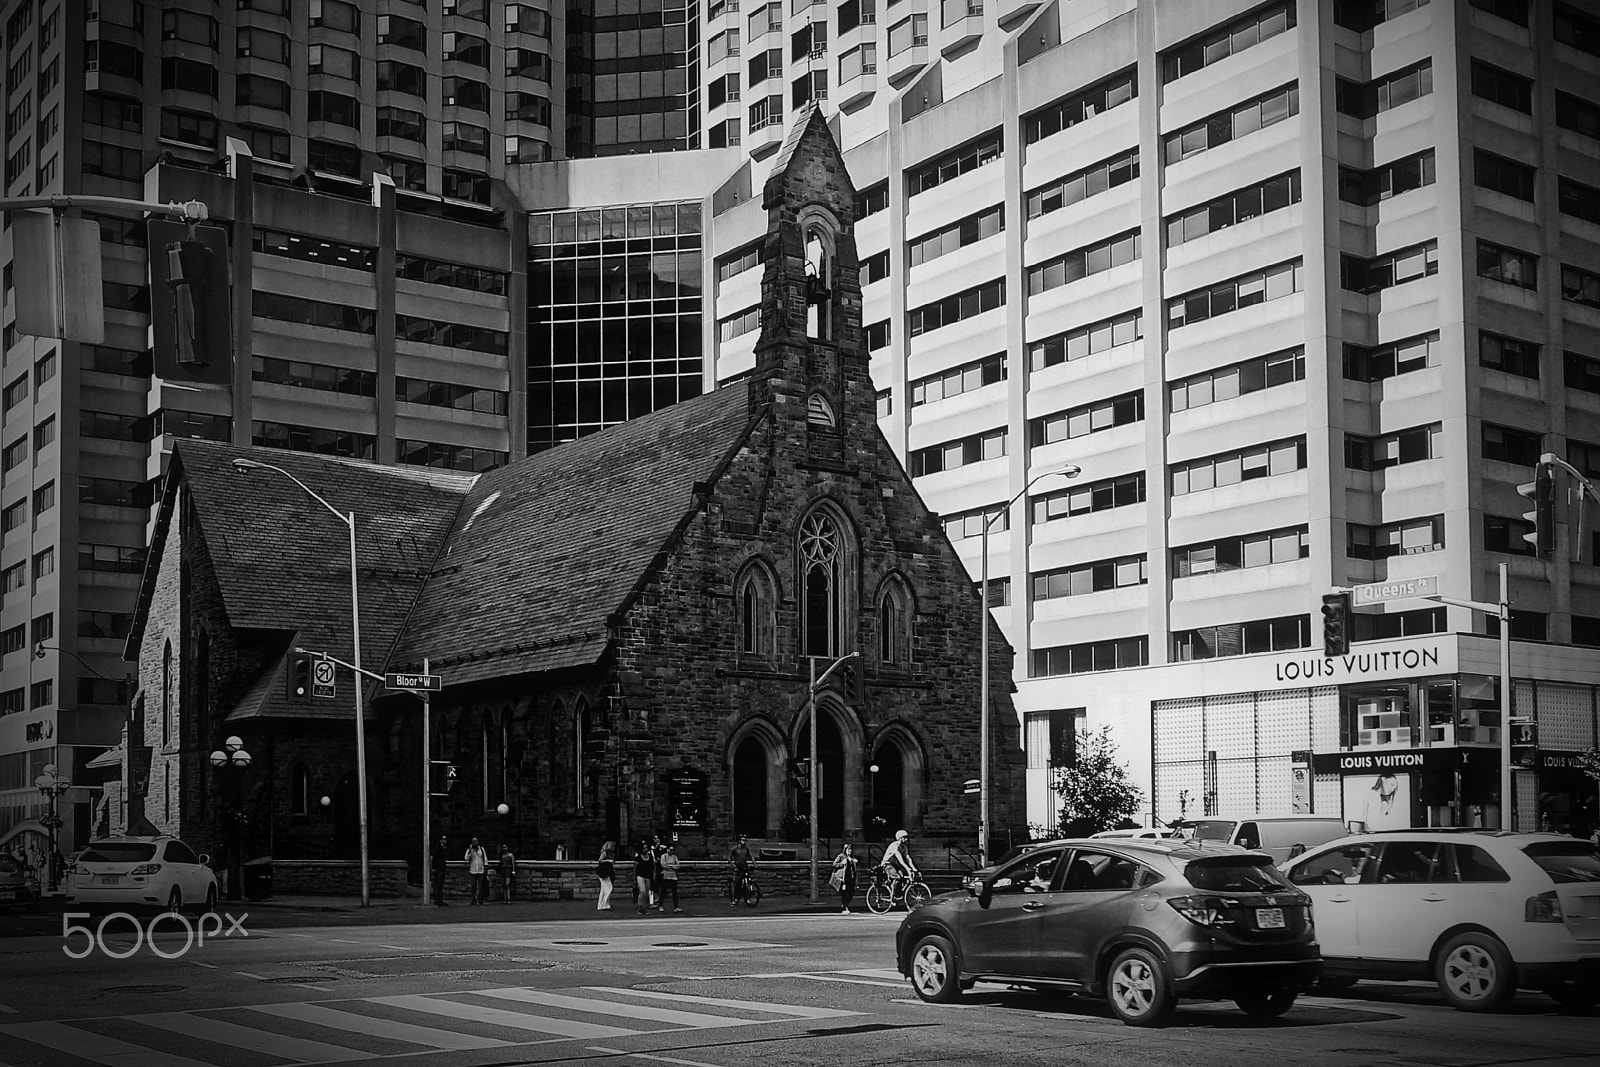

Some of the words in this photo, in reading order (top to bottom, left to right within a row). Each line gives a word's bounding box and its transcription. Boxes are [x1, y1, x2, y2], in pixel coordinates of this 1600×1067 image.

[1364, 583, 1415, 598] Queens
[1276, 658, 1334, 681] LOUIS
[1342, 647, 1438, 673] VUITTON
[396, 675, 417, 686] Bloor
[423, 677, 431, 687] W
[1340, 757, 1372, 769] LOUIS
[1375, 754, 1423, 767] VUITTON
[1543, 756, 1565, 767] LOUIS
